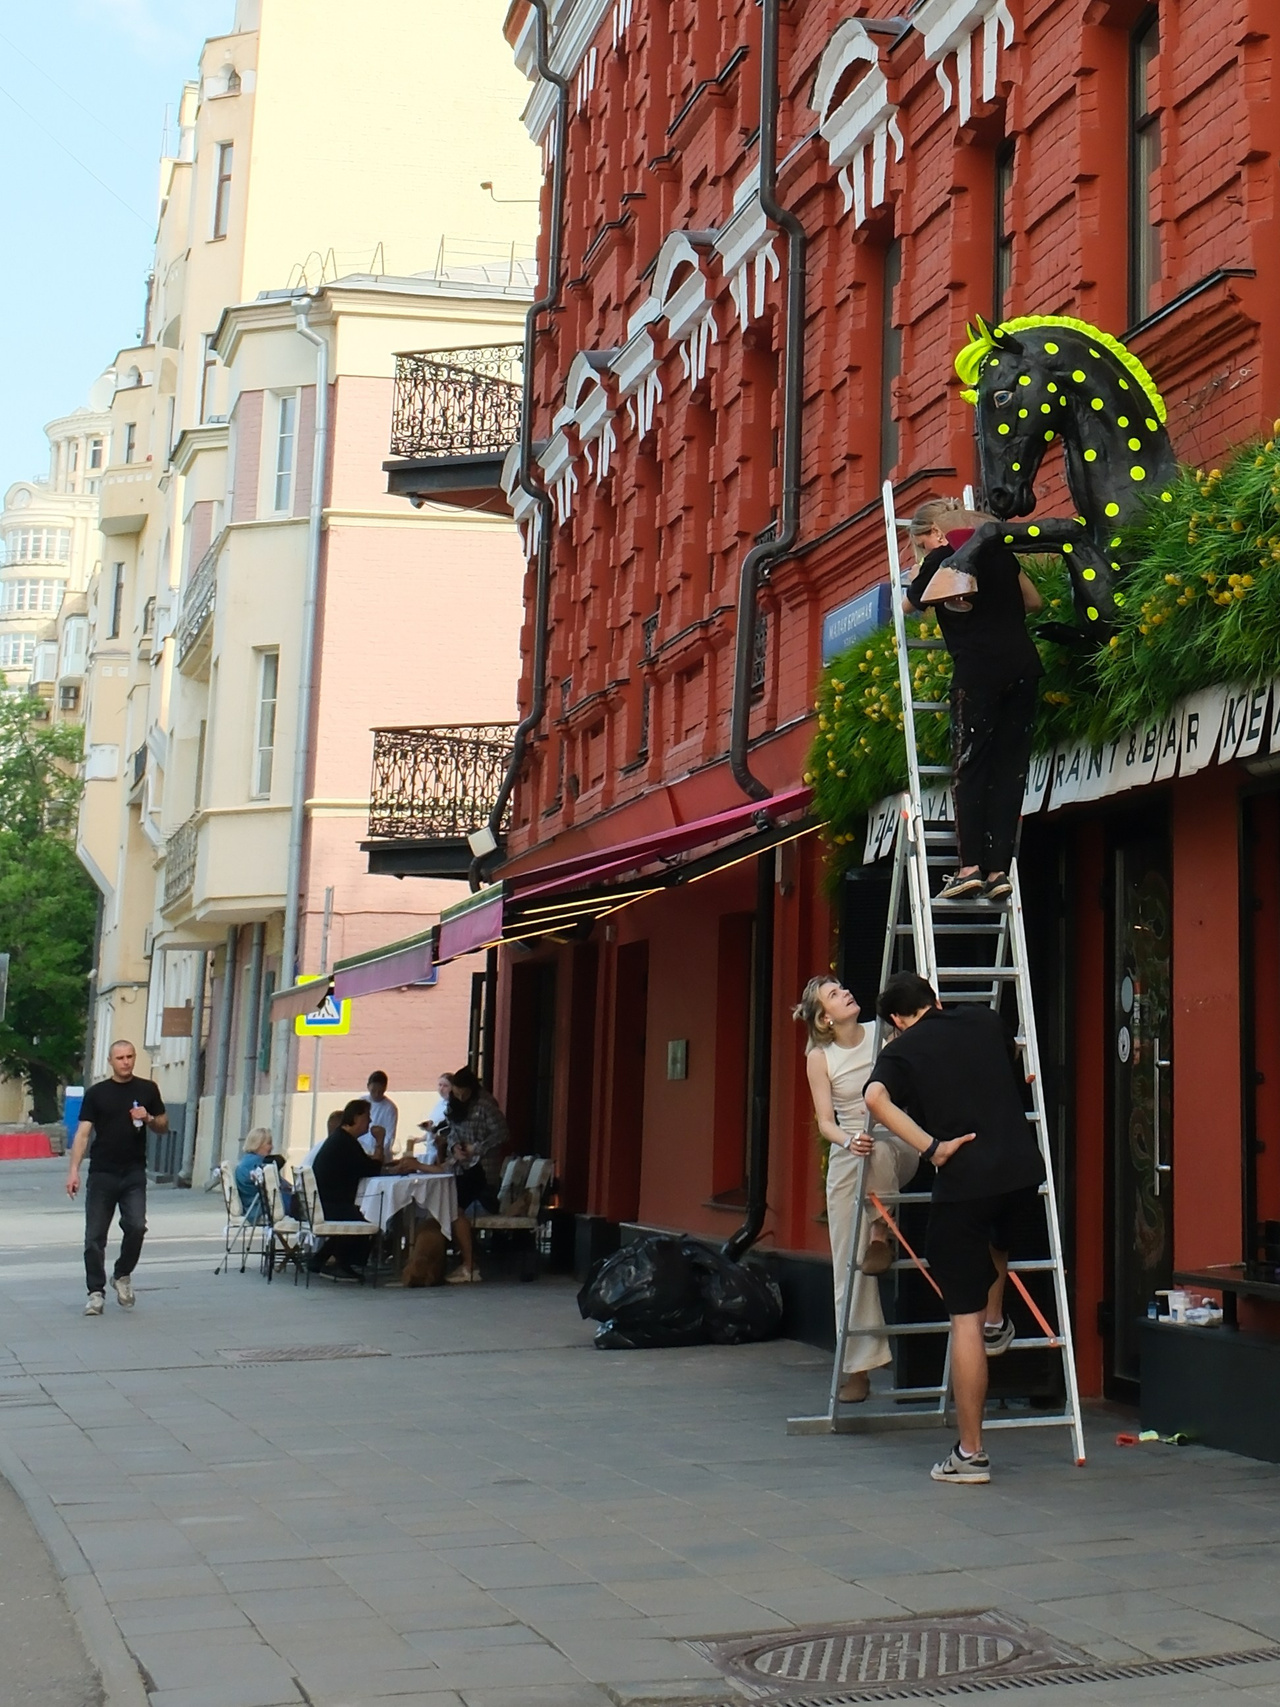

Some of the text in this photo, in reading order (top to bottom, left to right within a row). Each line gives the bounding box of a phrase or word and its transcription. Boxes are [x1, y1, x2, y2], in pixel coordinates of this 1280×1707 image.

[868, 791, 948, 846] IZAYA
[1126, 733, 1138, 767] &
[1142, 712, 1199, 763] BAR
